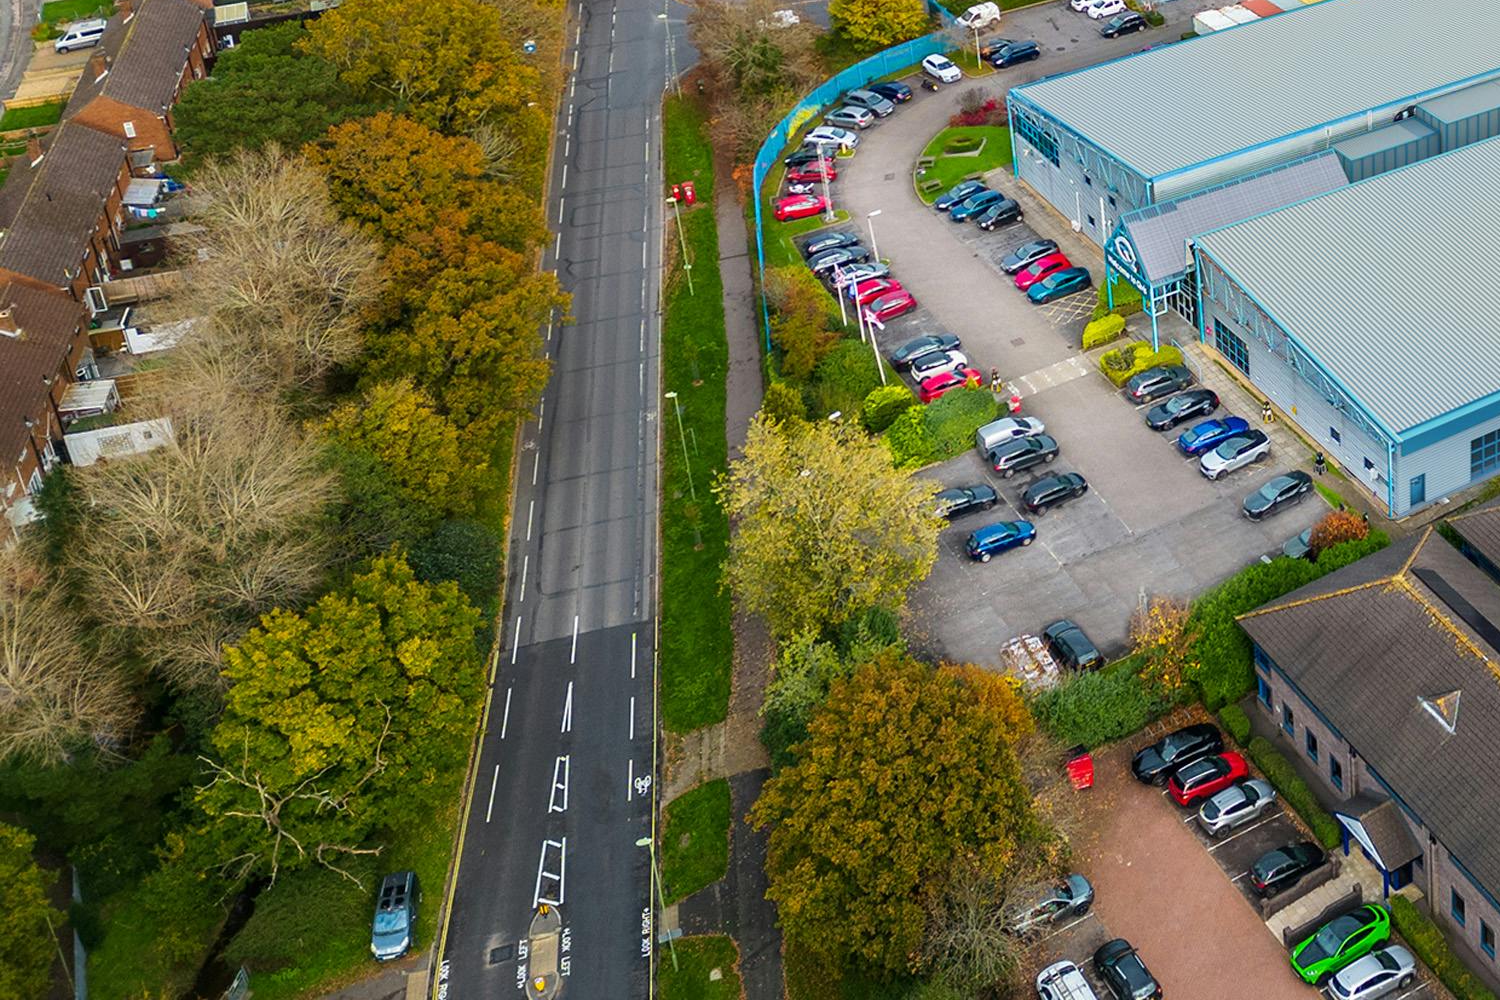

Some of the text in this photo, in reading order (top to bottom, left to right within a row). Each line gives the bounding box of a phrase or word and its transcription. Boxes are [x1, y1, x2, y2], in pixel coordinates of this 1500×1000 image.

[561, 932, 572, 976] LOOK LEFT
[641, 912, 650, 957] LOOK RIGHT
[440, 960, 450, 982] LOOK
[517, 940, 528, 984] LOOK LEFT
